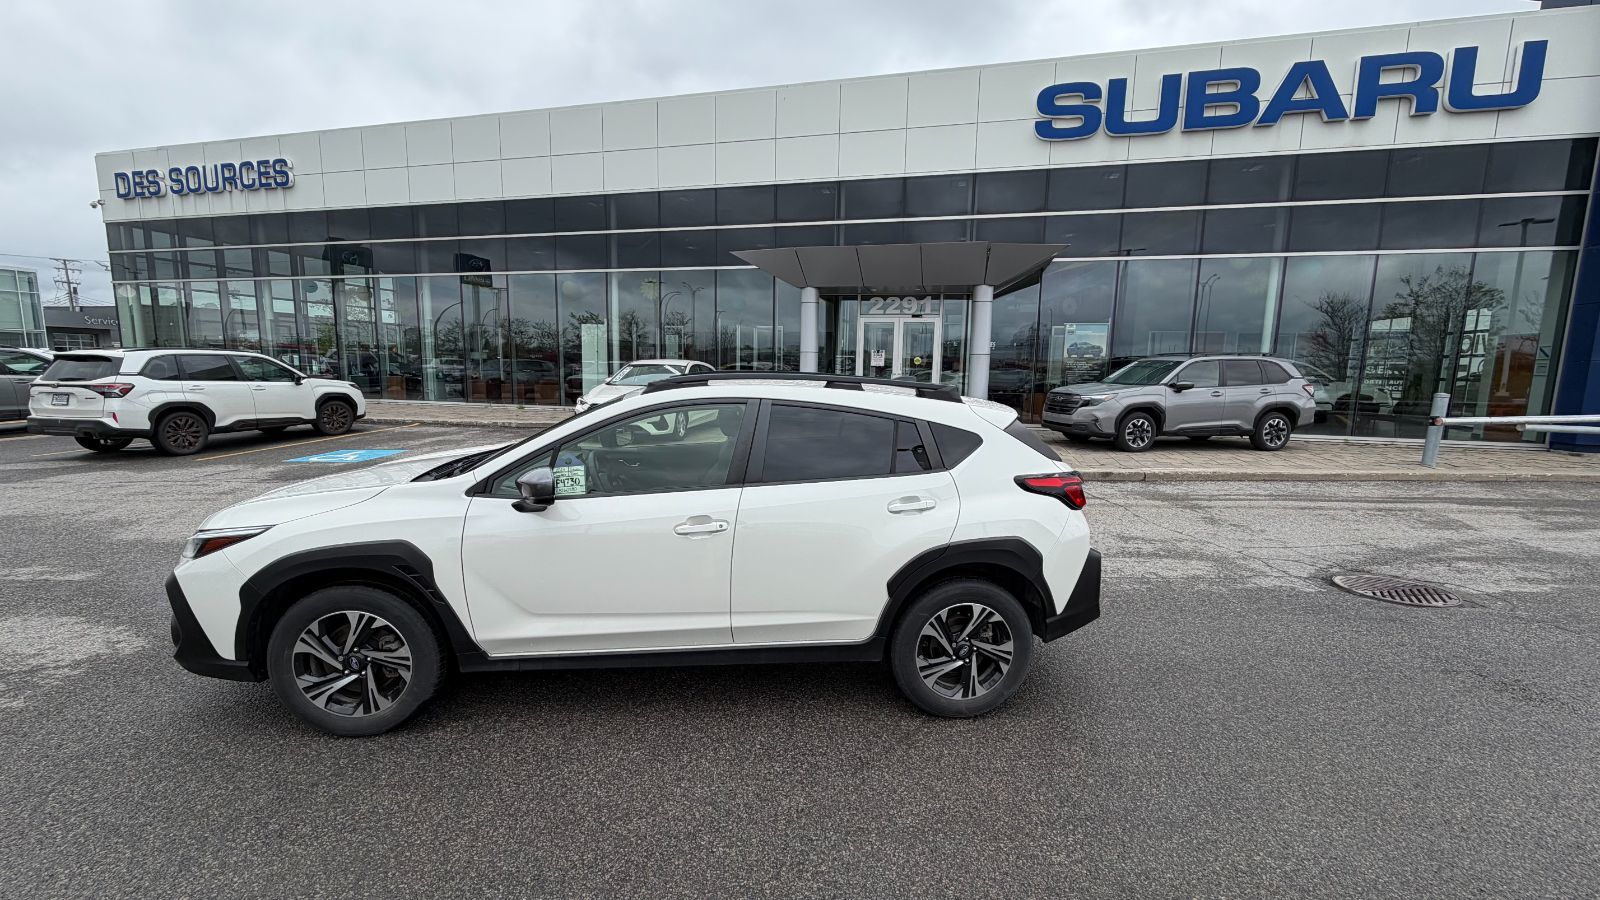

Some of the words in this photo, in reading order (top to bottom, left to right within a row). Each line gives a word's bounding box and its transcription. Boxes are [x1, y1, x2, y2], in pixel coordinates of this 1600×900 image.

[1034, 39, 1548, 141] SUBARU
[114, 169, 163, 199] DES
[168, 158, 291, 196] SOURCES
[868, 296, 932, 314] 2291
